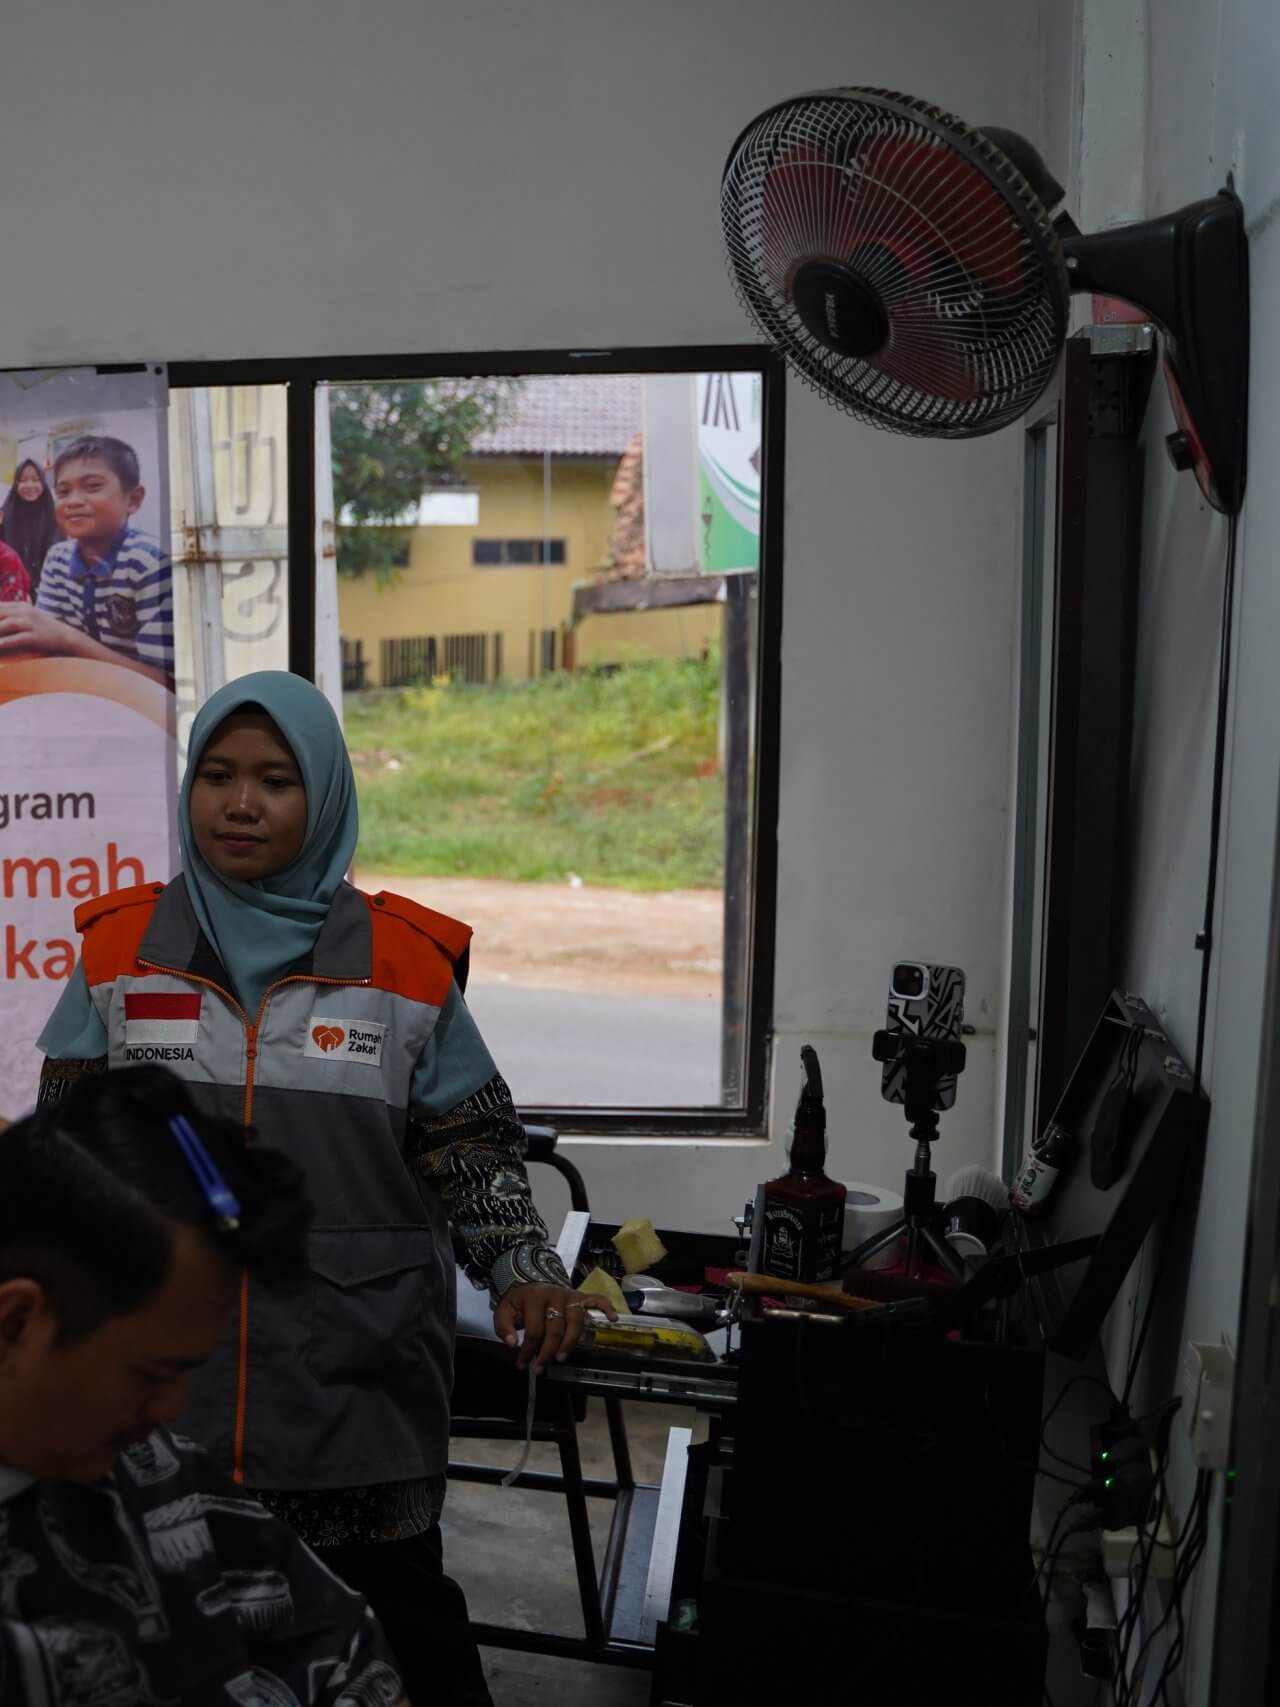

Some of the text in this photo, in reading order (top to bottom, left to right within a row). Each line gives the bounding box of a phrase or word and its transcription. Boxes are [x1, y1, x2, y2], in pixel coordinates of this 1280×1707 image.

[349, 1029, 382, 1044] Rumah
[126, 1047, 194, 1061] INDONESIA
[348, 1041, 377, 1056] Zakat
